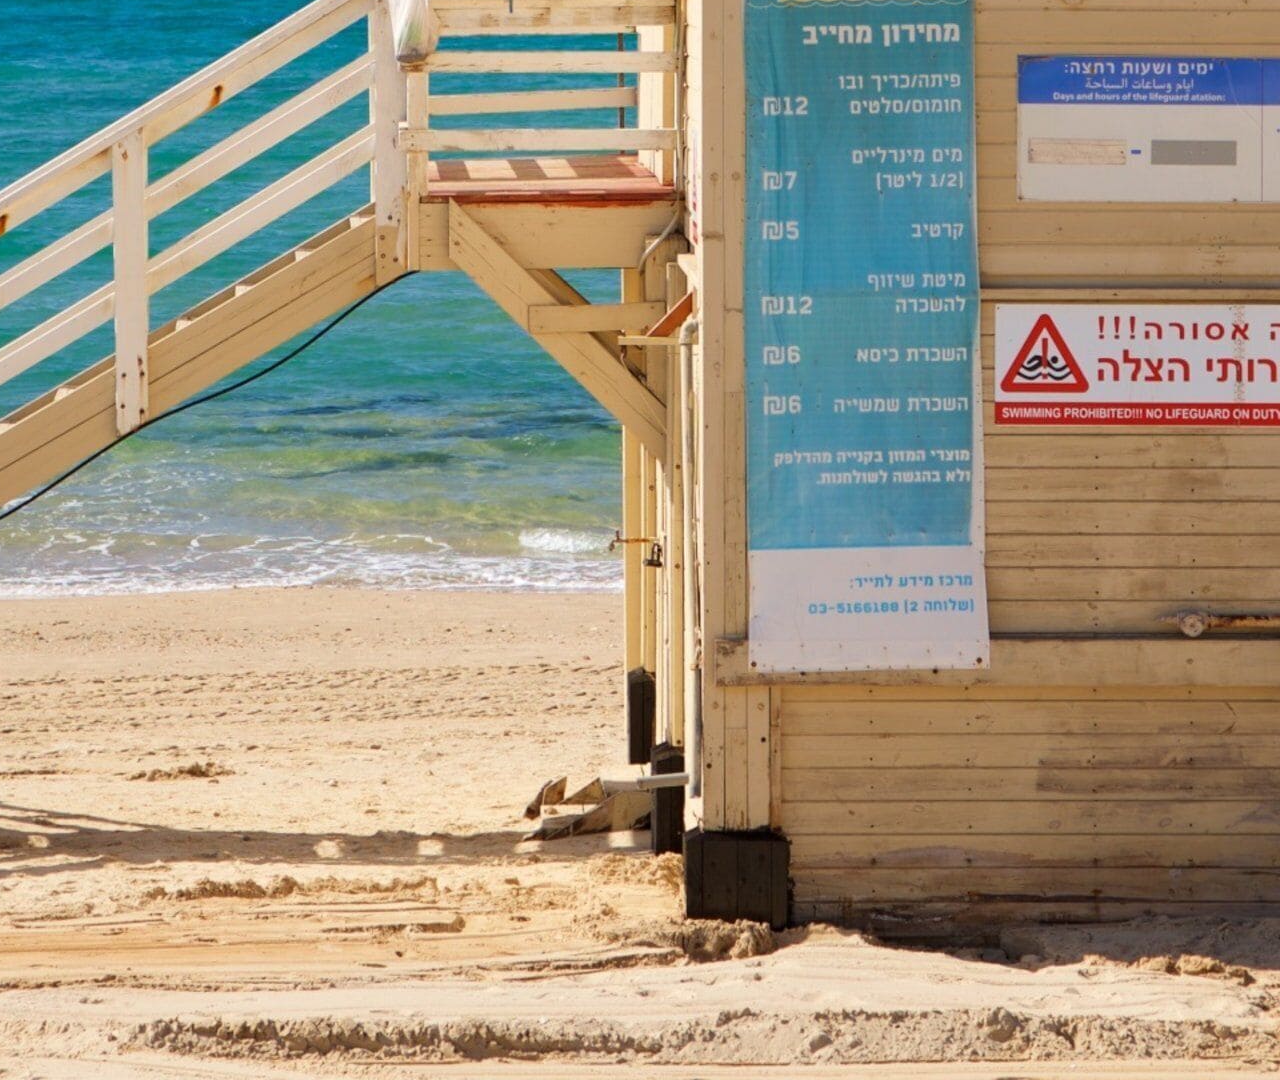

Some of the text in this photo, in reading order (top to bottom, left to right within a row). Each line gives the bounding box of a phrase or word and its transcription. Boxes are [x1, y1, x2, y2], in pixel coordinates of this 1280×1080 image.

[802, 23, 960, 47] מחירון מחייב
[1065, 62, 1214, 76] ימים ושעות רחצה:
[838, 74, 961, 92] פיתה/כריך ובו
[850, 97, 961, 114] חומוס/סלטים
[1053, 92, 1074, 102] Days
[1076, 92, 1093, 101] and
[1095, 93, 1120, 101] hours
[1121, 93, 1131, 101] of
[1132, 93, 1147, 101] the
[1149, 93, 1189, 103] lifeguard
[852, 147, 963, 163] מים מינרליים
[911, 223, 964, 240] קרטיב
[867, 273, 966, 291] מיטת שיזוף
[895, 295, 966, 313] להשכרה
[856, 346, 967, 363] השכרת כיסא
[1098, 349, 1190, 382] הצלה
[833, 396, 968, 413] השכרת שמשייה
[1002, 407, 1061, 419] SWIMMING
[1064, 407, 1143, 419] PROHIBITED!!!
[1146, 408, 1163, 419] NO
[1165, 408, 1230, 420] LIFEGUARD
[1234, 408, 1251, 420] ON
[774, 449, 970, 467] מוצרי המזון בקנייה מהדלפק
[893, 471, 940, 483] בהגשה
[946, 469, 970, 482] ולא
[850, 574, 973, 588] מרכז מידע לתייר:
